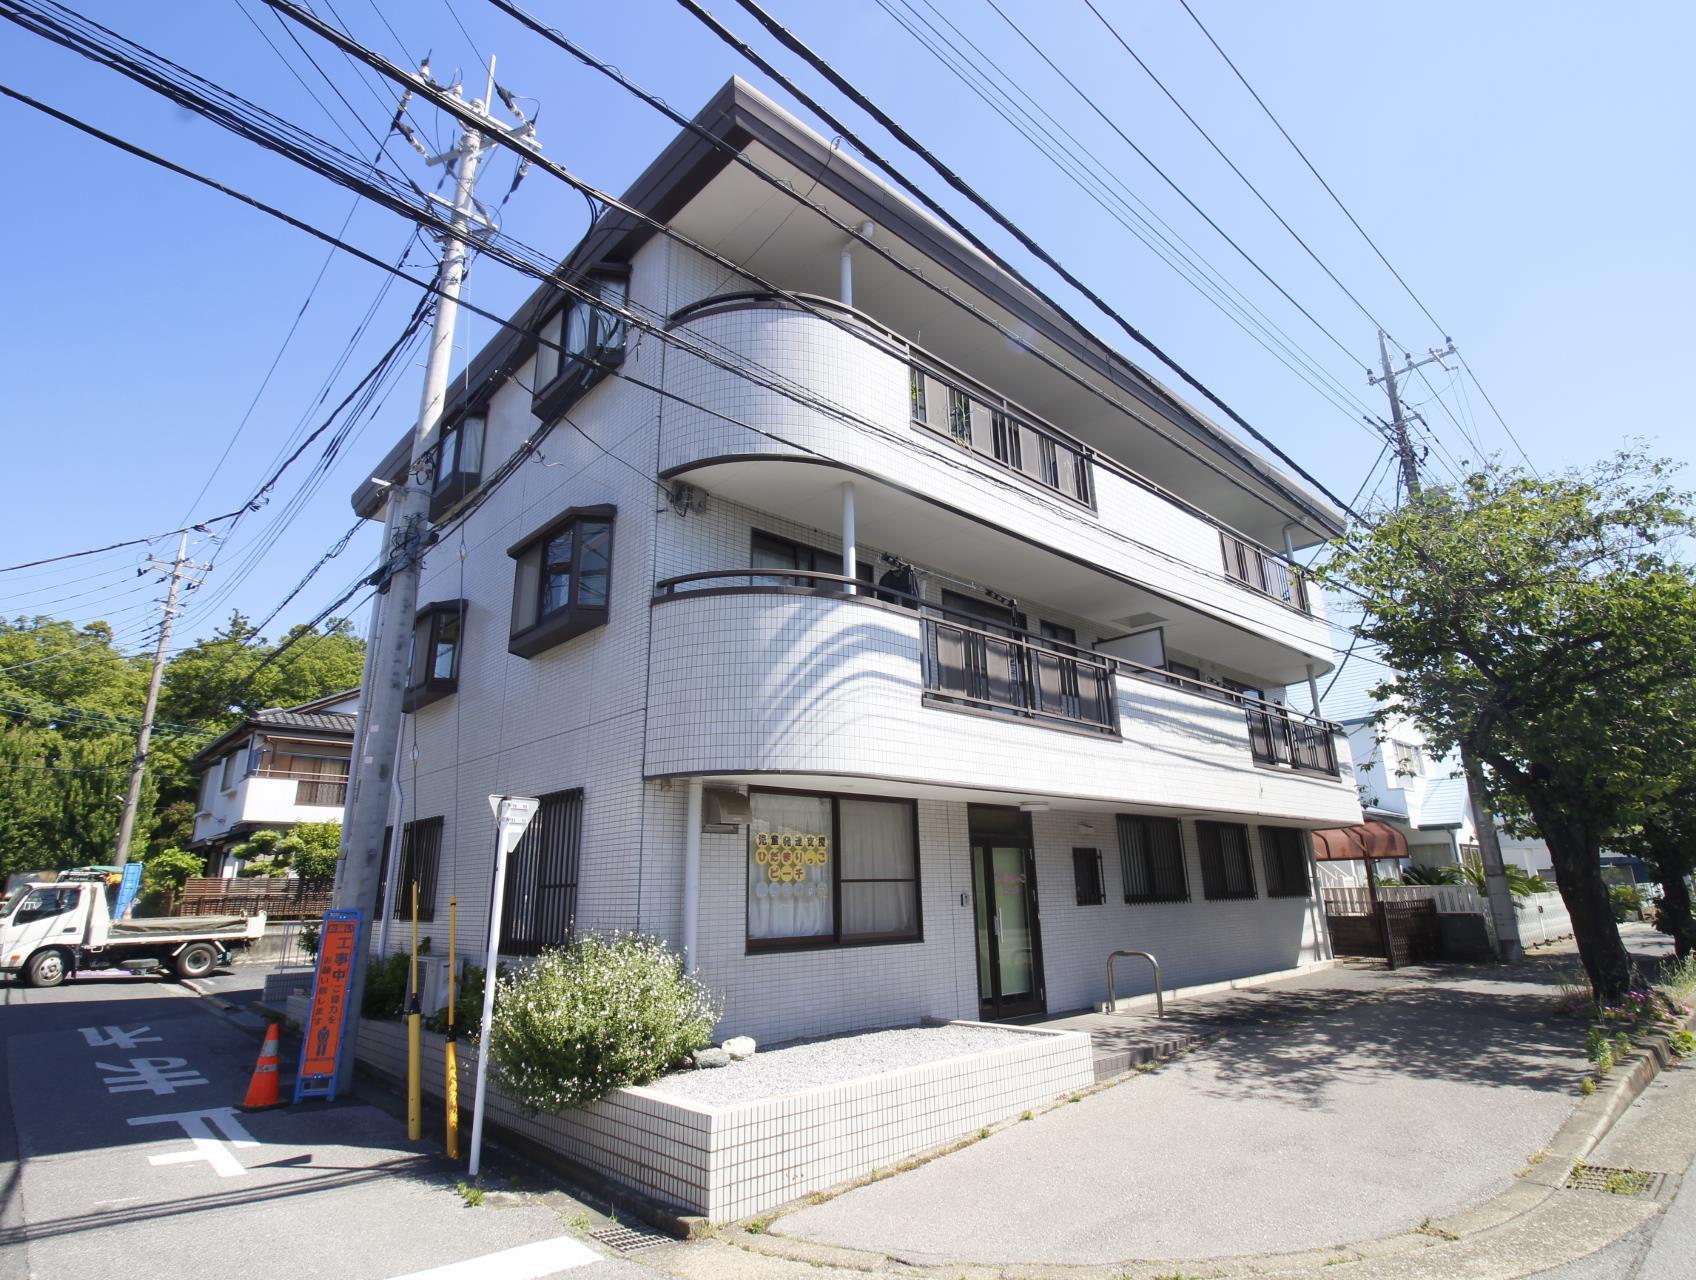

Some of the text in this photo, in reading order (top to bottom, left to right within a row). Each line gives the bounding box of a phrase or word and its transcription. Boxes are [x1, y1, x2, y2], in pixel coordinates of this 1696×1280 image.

[758, 834, 826, 847] 児童発達支援
[758, 851, 826, 864] ひだまりっこ
